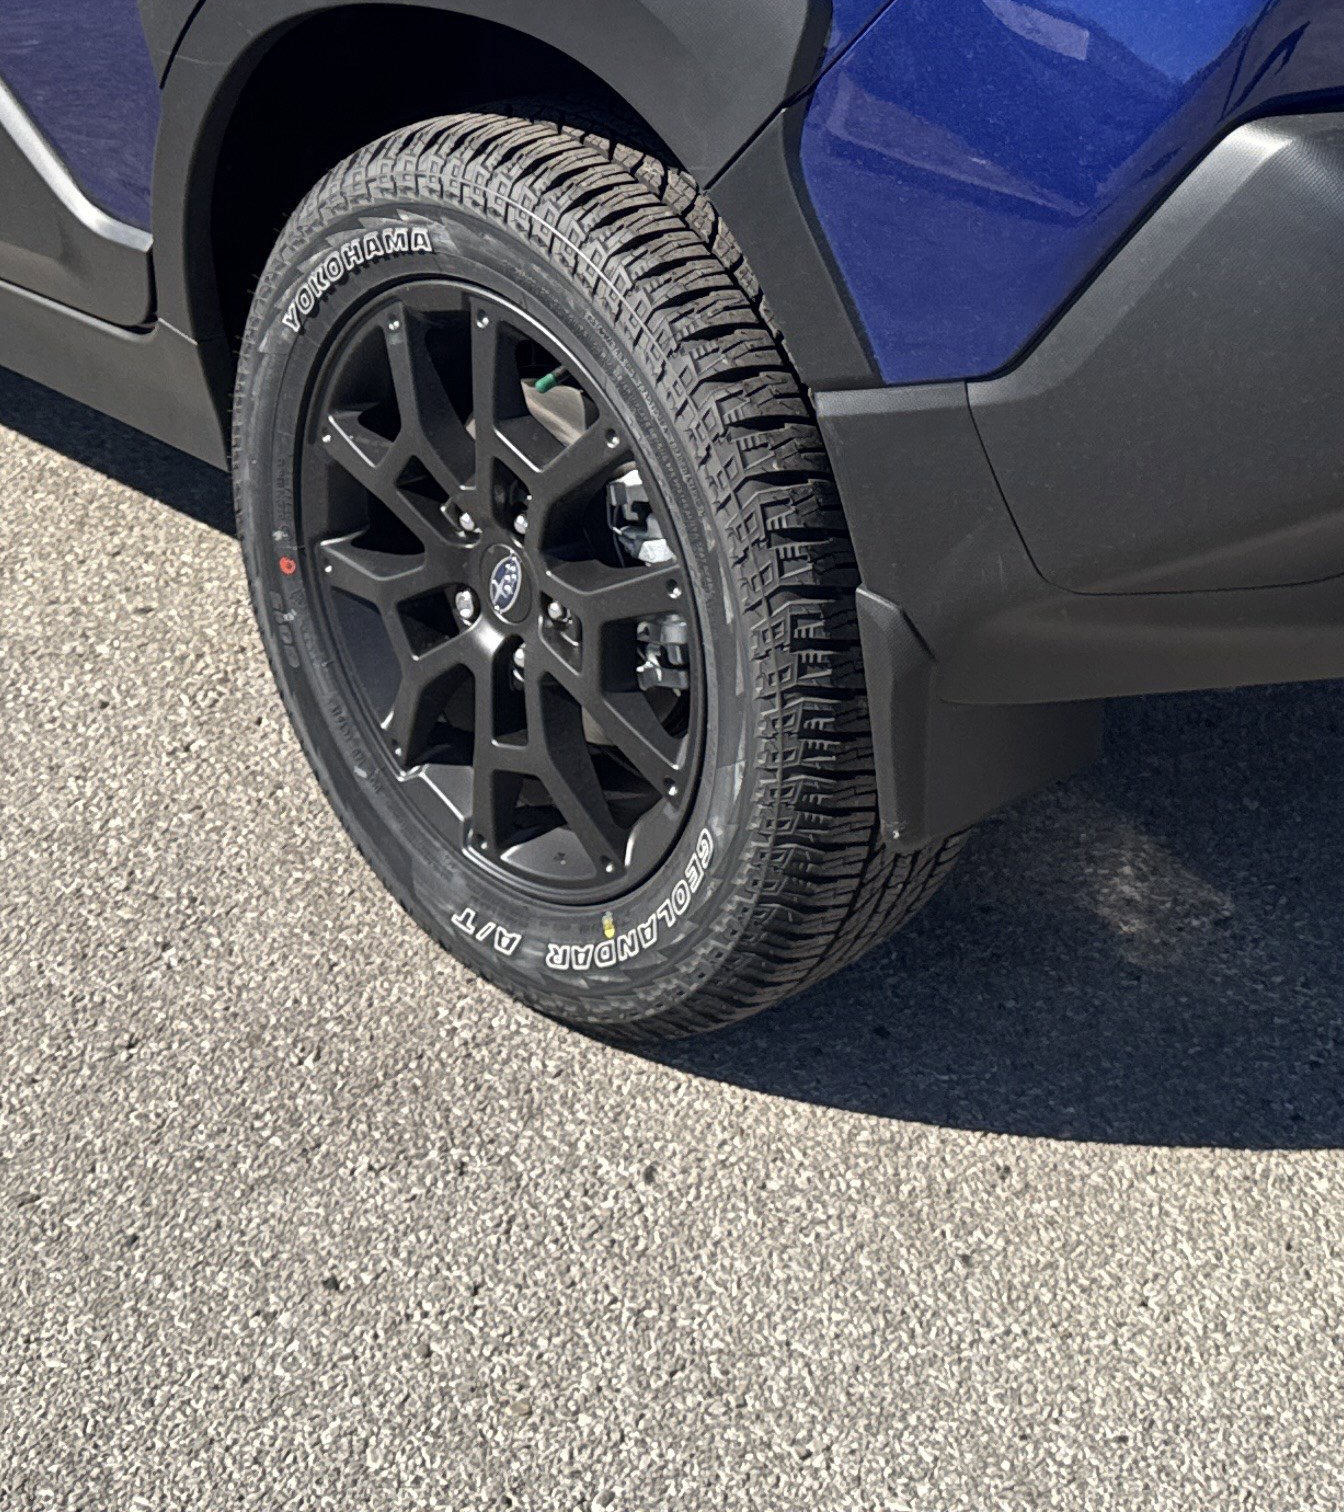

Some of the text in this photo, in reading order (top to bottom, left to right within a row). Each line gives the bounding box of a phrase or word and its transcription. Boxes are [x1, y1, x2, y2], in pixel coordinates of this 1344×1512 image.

[282, 227, 433, 332] YOKOHAMA
[451, 828, 715, 970] GEOLANDAR A/T
